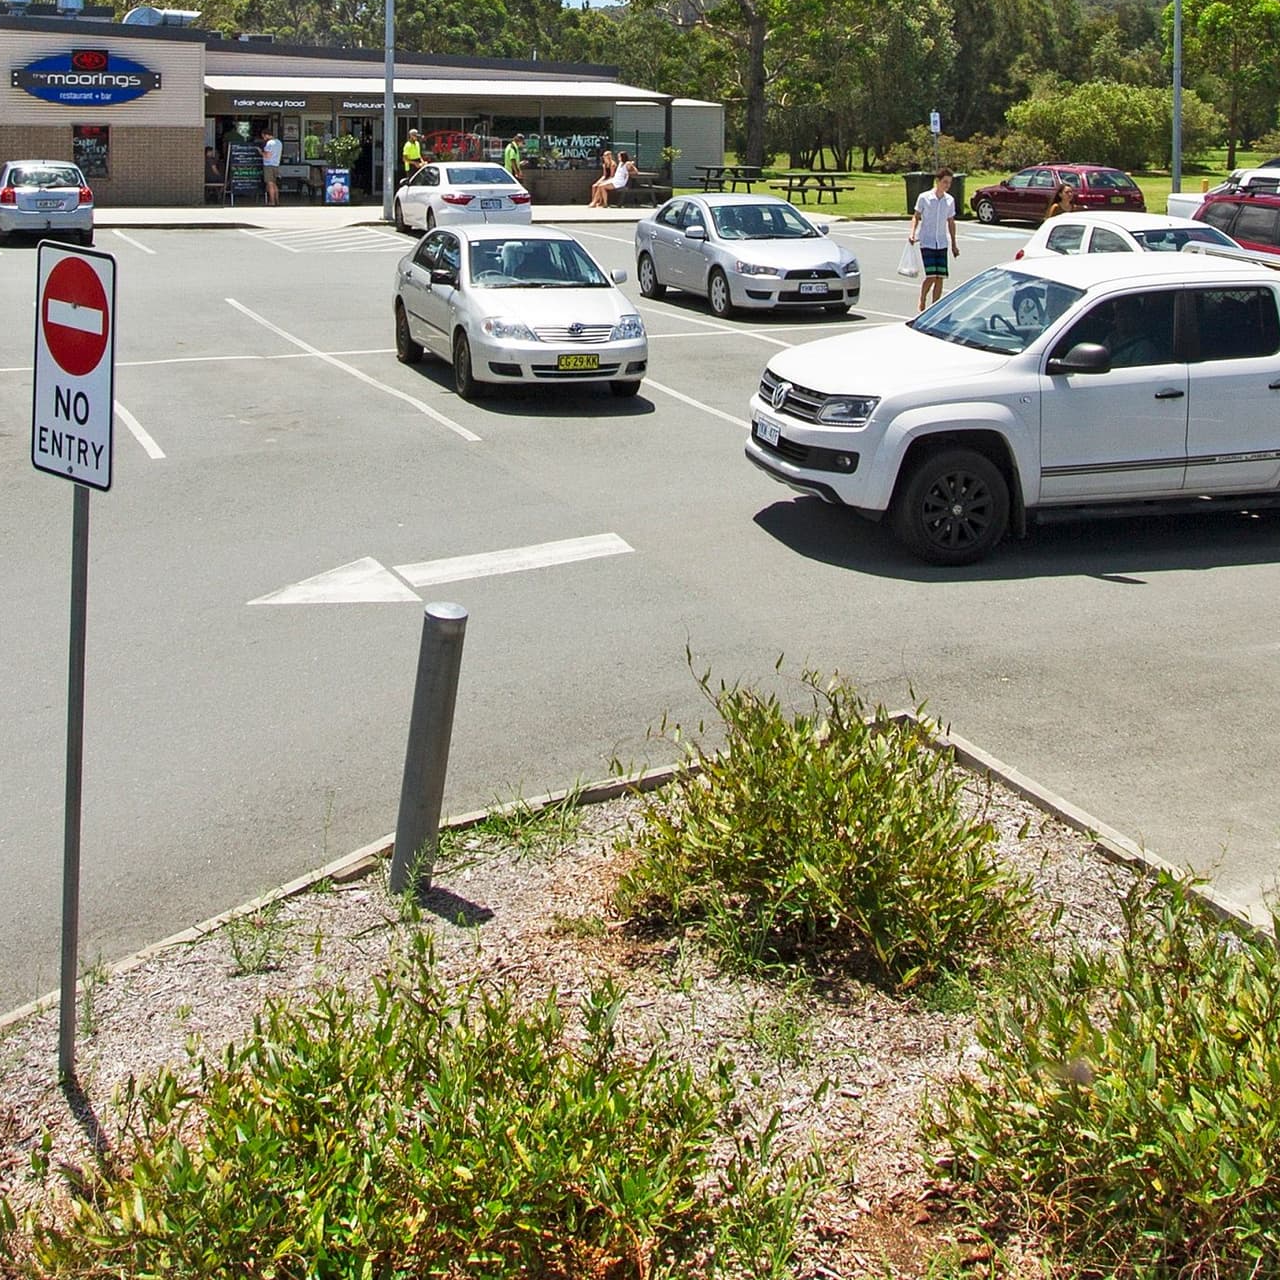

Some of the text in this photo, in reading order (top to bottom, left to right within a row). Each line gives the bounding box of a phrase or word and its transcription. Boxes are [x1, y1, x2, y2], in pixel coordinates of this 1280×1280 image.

[47, 72, 141, 88] moorings
[59, 92, 93, 100] restaurant
[100, 92, 112, 100] bar
[547, 135, 568, 146] Live
[55, 385, 89, 425] NO
[39, 426, 104, 471] ENTRY
